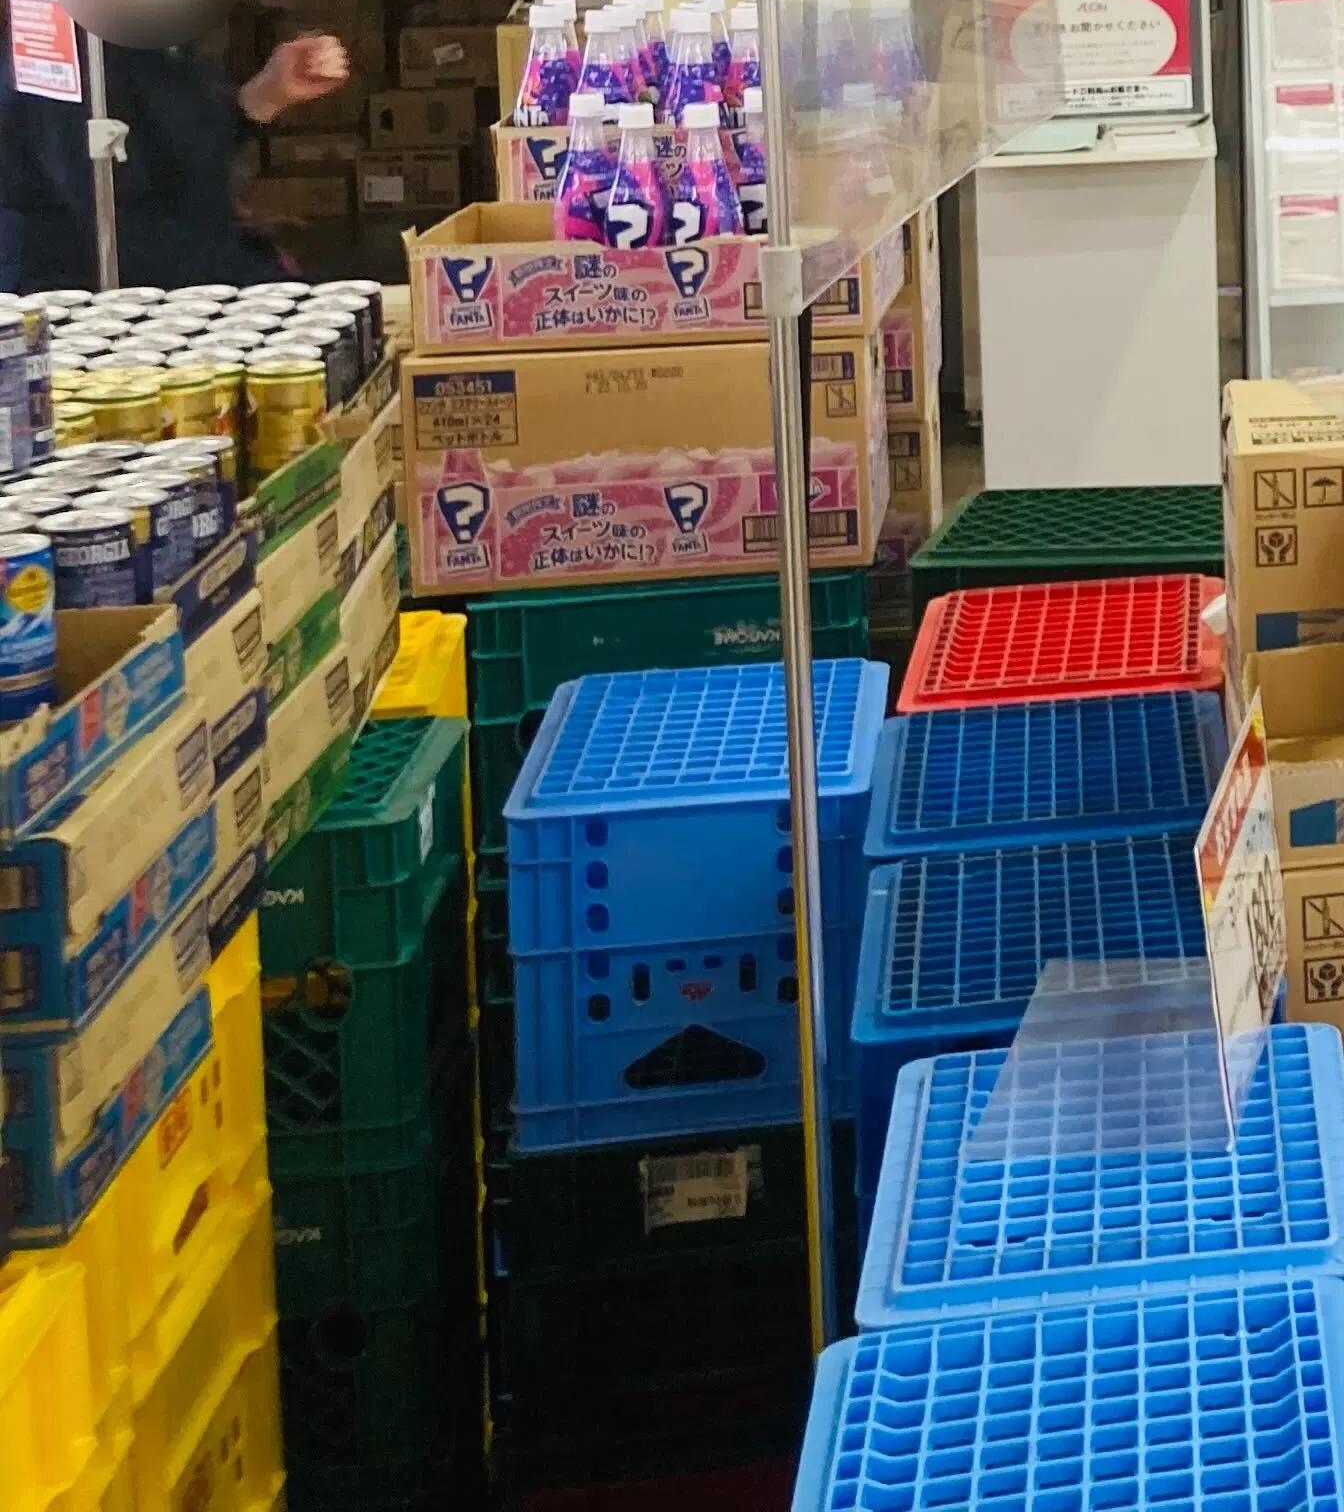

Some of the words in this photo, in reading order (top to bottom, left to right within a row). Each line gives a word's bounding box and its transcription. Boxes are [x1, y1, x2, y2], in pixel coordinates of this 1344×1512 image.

[573, 254, 617, 280] 謎の
[544, 283, 649, 307] スイーツ味の
[534, 304, 656, 333] 正体はいかに!?
[571, 492, 617, 518] 謎の
[542, 522, 647, 546] スイーツ味の
[532, 543, 655, 572] 正体はいかに!?
